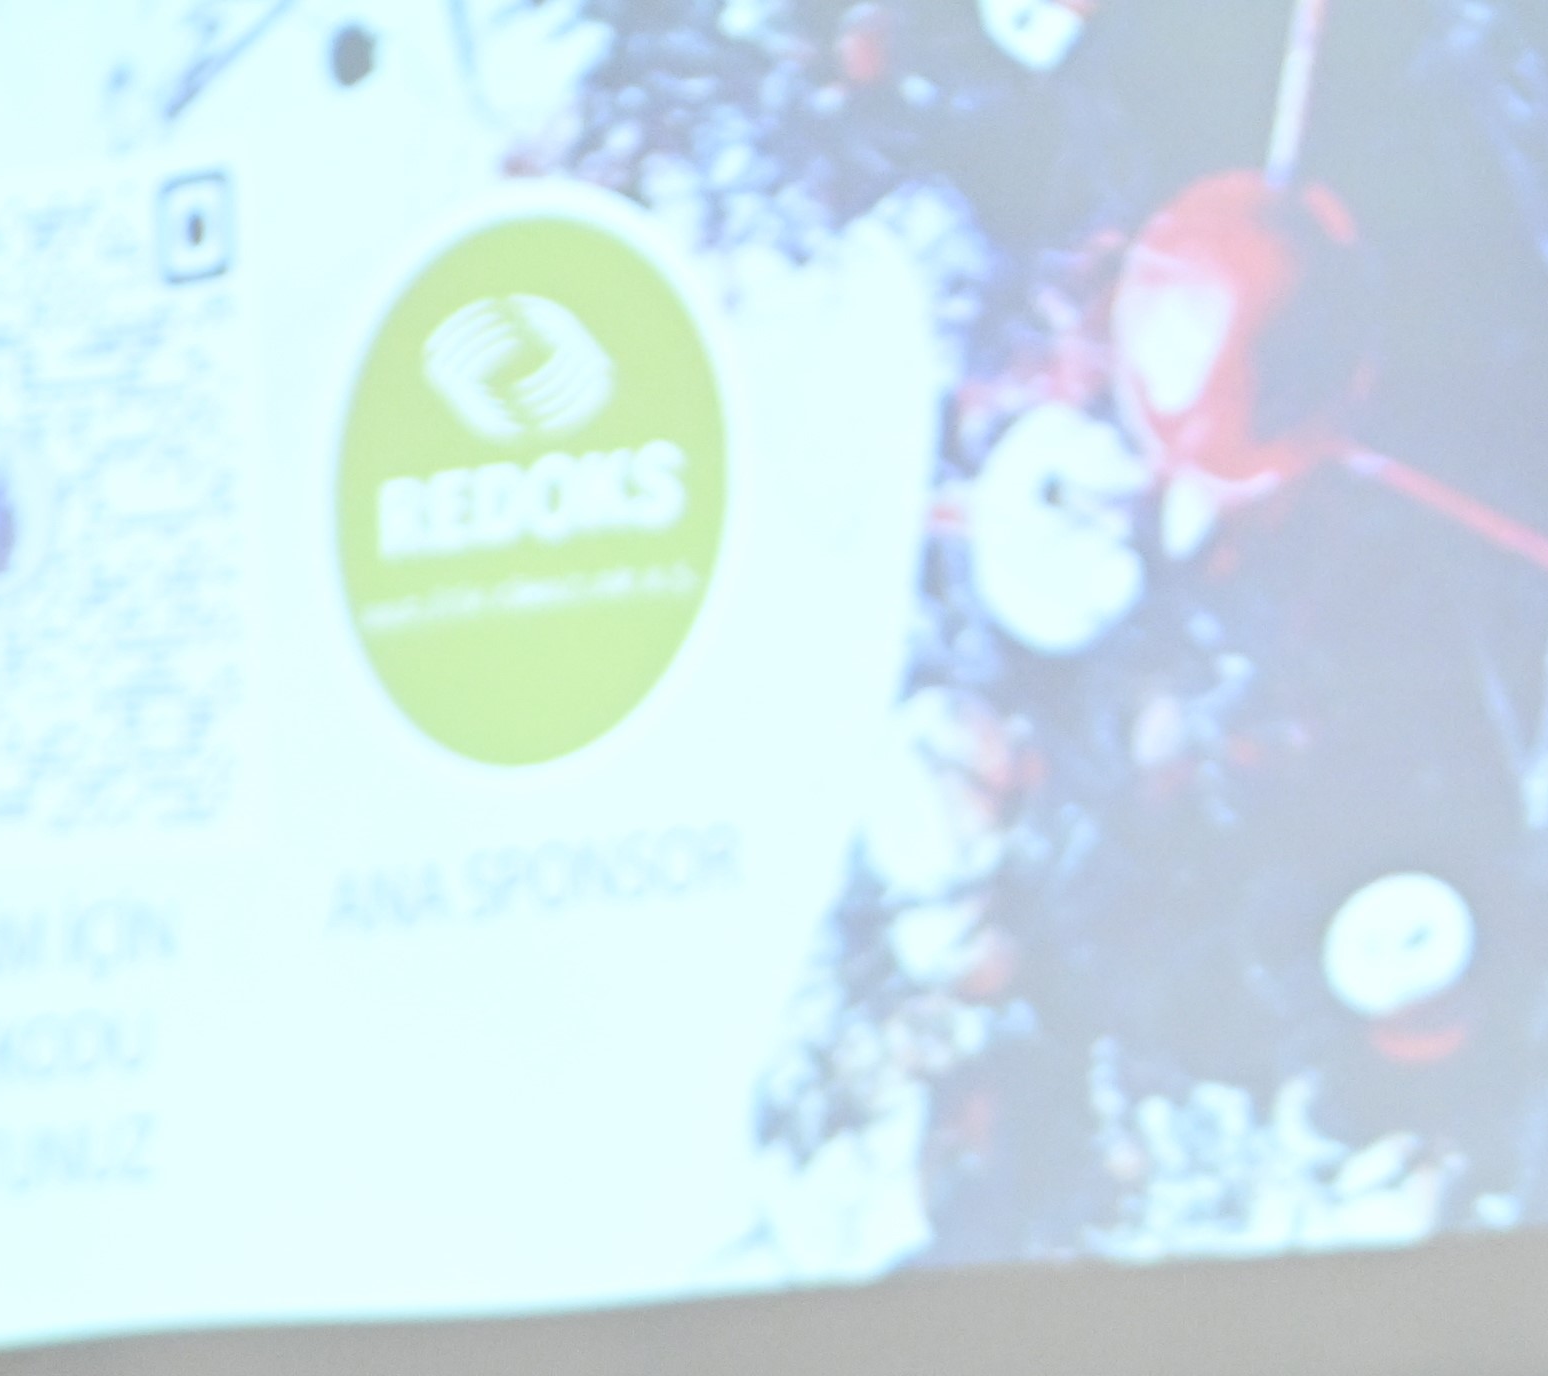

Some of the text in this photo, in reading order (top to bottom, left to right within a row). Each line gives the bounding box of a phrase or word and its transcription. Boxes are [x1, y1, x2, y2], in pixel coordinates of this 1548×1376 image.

[377, 438, 690, 562] REDOKS
[326, 819, 747, 934] ANA SPONSOR
